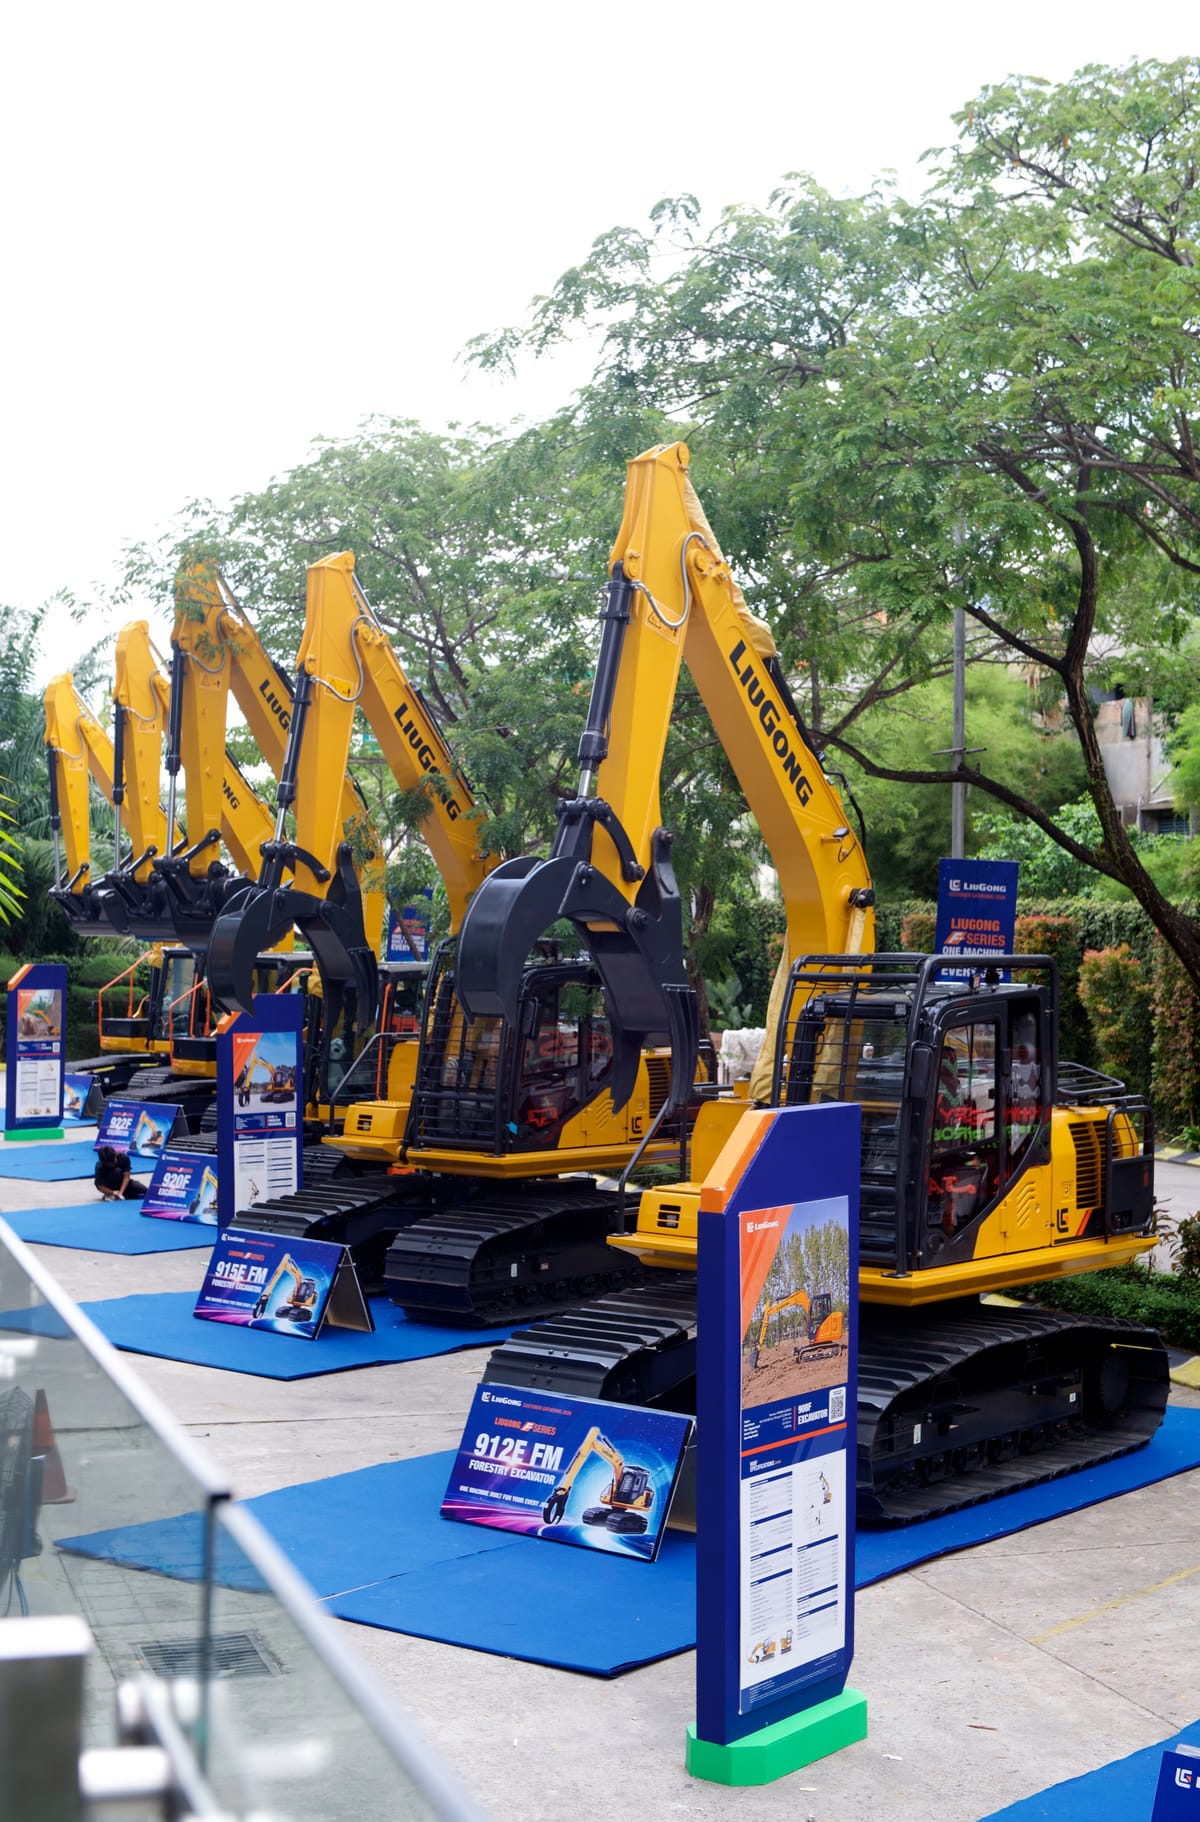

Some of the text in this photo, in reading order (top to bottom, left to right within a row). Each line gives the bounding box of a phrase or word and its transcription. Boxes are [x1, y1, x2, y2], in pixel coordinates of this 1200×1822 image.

[729, 639, 813, 807] LIUGONG
[951, 917, 1000, 932] LIUGONG
[966, 934, 1006, 947] SERIES
[162, 1171, 192, 1189] 920F
[215, 1260, 269, 1284] 915E FM
[533, 1424, 557, 1436] SERIES
[473, 1433, 564, 1471] 912E FM
[468, 1459, 555, 1485] FORESTRY EXCAVATOR
